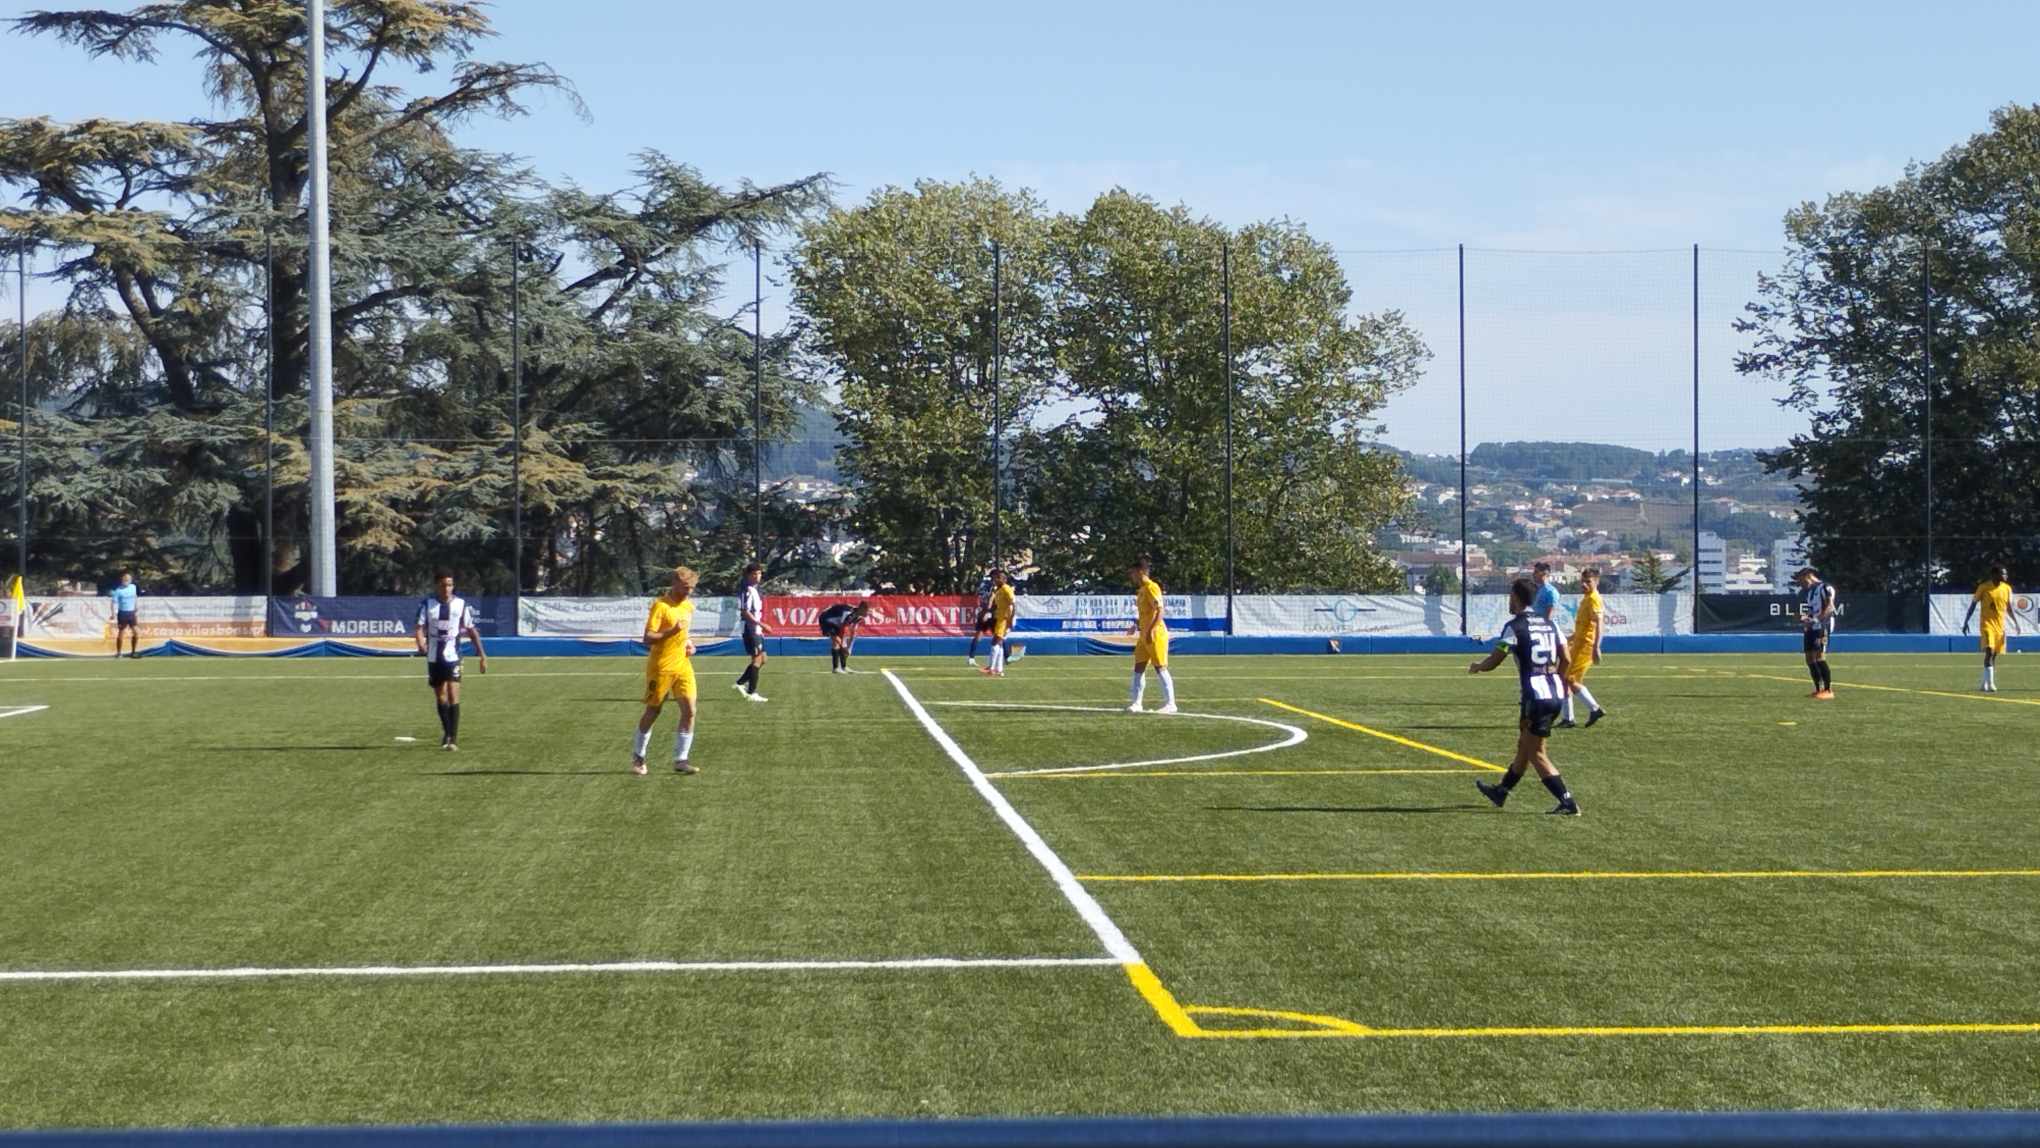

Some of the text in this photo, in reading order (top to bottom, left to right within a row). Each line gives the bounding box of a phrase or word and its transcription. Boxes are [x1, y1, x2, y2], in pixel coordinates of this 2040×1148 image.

[774, 607, 820, 625] VOZ
[1770, 603, 1845, 616] BLEM
[332, 620, 406, 633] MOREIRA
